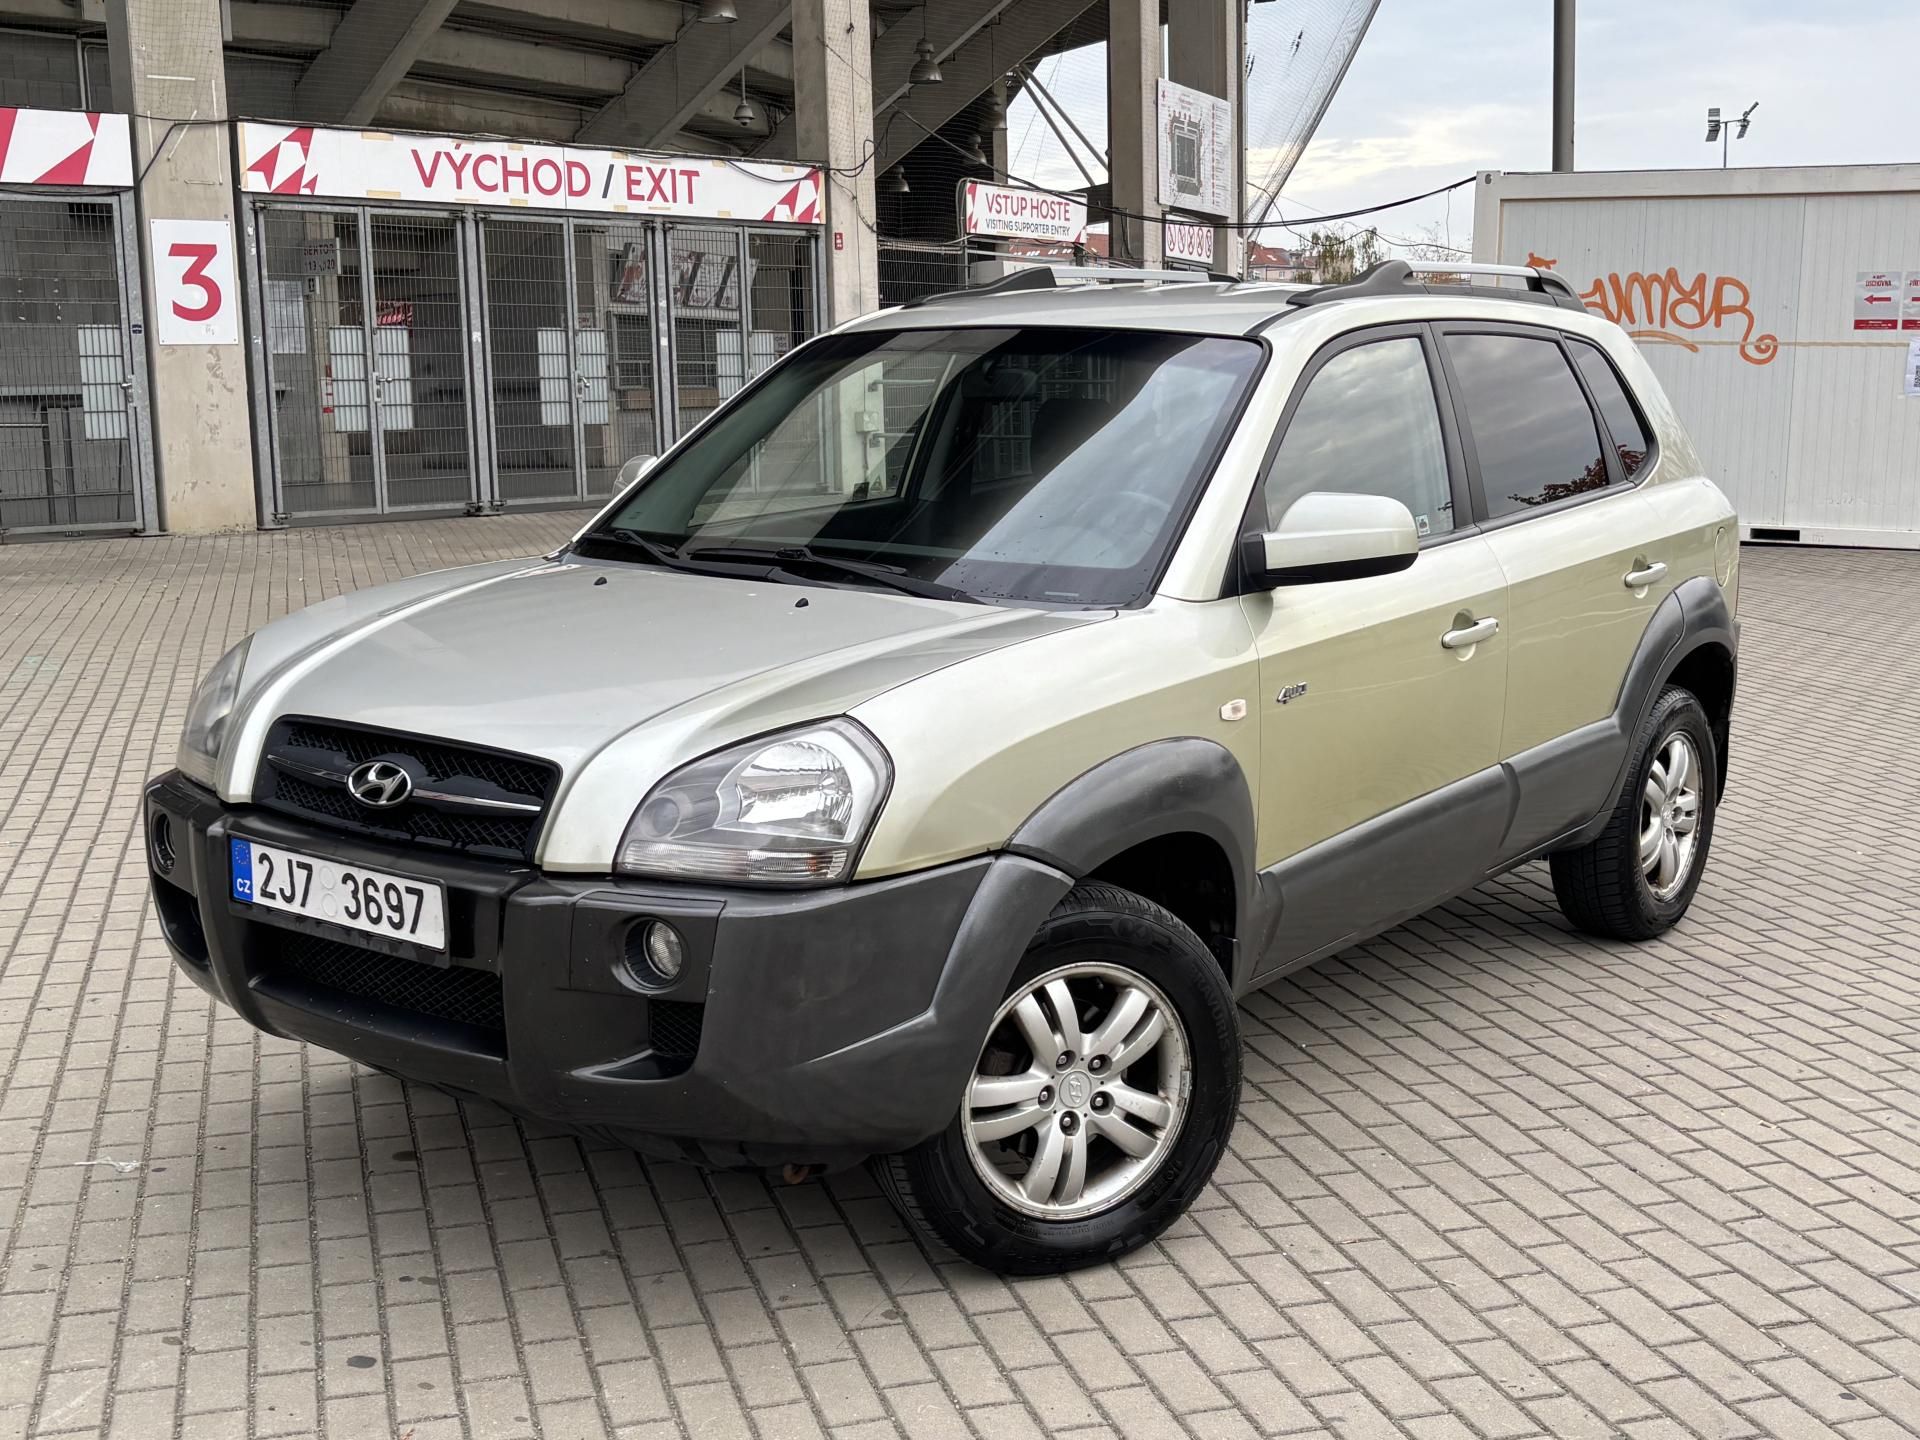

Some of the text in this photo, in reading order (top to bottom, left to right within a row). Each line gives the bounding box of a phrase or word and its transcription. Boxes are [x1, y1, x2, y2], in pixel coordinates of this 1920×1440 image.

[411, 143, 700, 204] VÝCHOD / EXIT
[985, 192, 1071, 222] VSTUP HOSTE
[985, 218, 1071, 237] VISITING SUPPORTER ENTRY
[168, 243, 222, 322] 3
[236, 878, 251, 894] CZ
[258, 852, 424, 934] 2J7 3697
